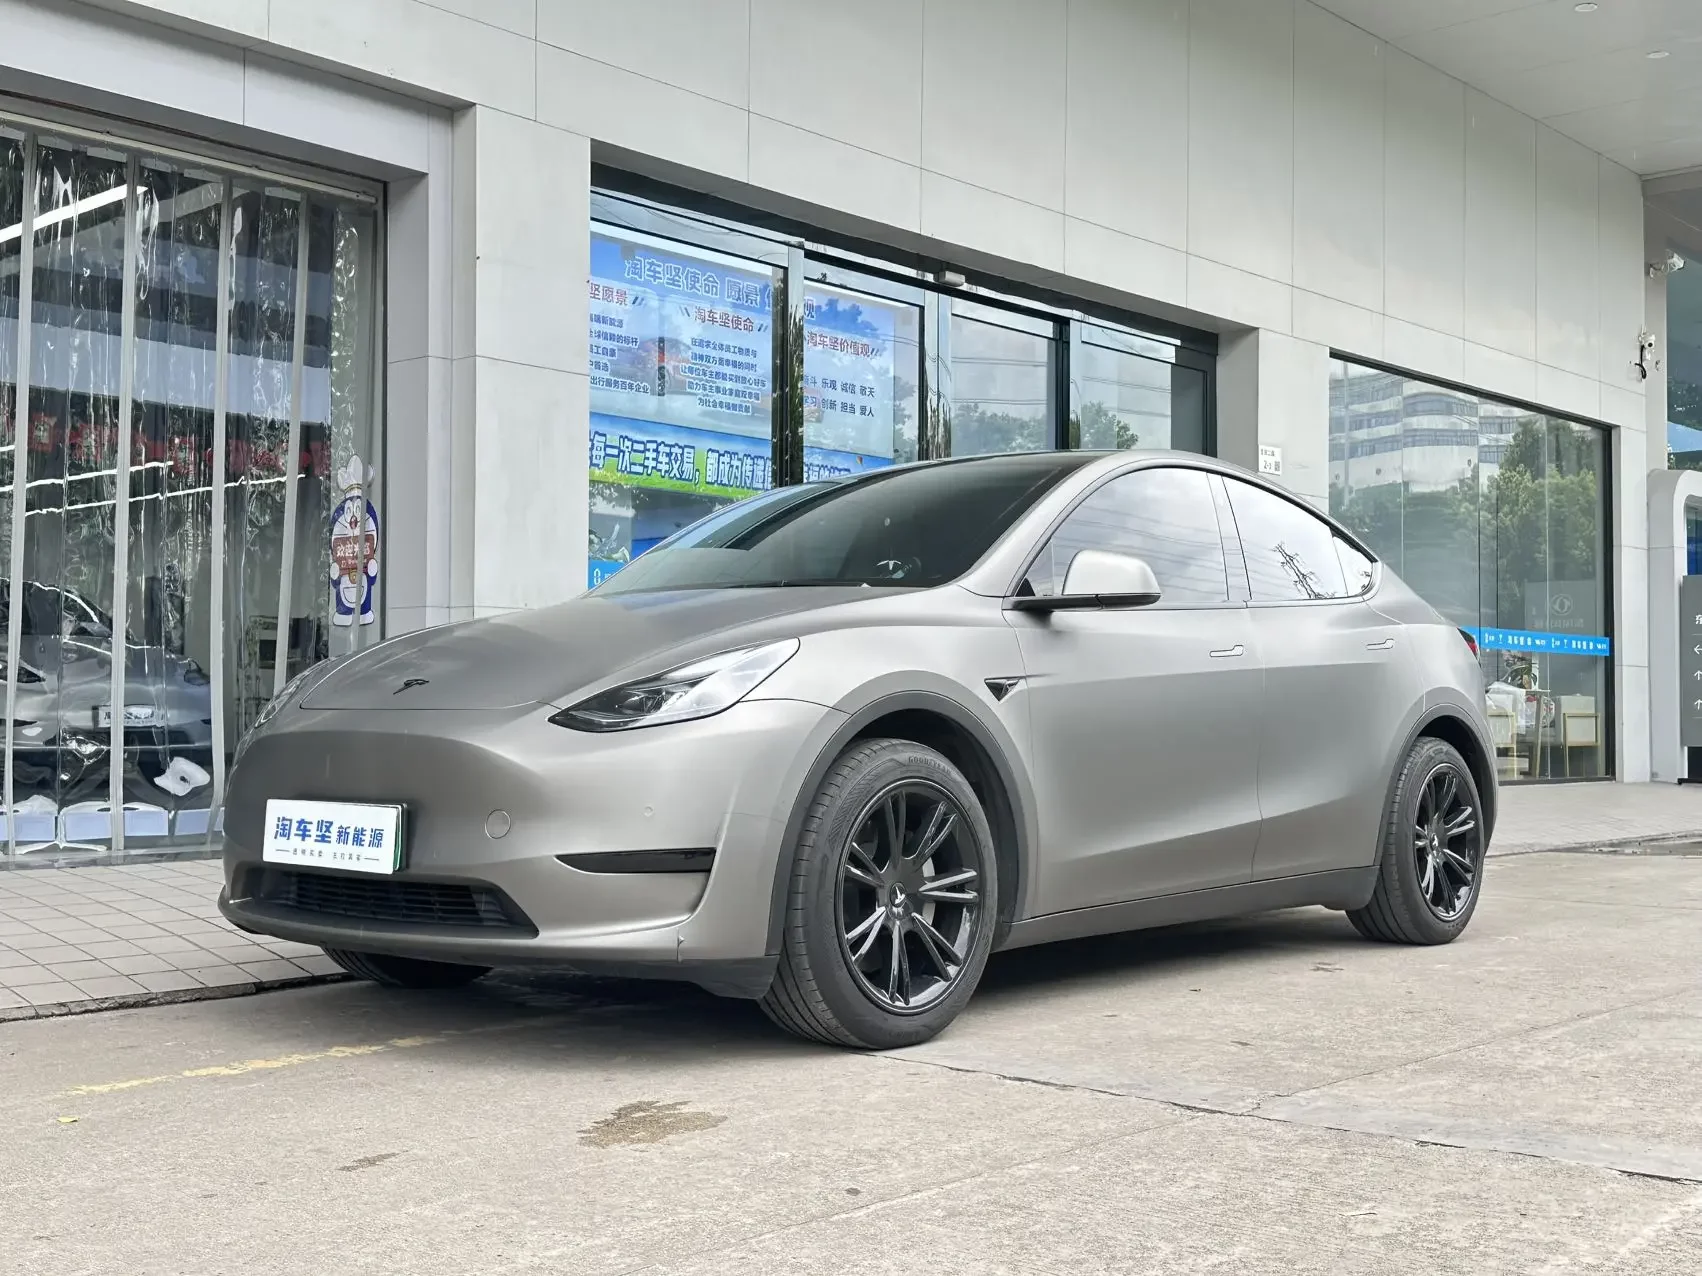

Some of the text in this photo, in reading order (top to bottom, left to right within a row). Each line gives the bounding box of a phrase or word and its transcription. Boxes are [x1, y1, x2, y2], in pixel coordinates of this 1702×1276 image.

[624, 256, 720, 298] 淘车坚使命
[695, 306, 754, 333] 淘车坚使命
[807, 330, 869, 357] 淘车坚价值观
[590, 376, 650, 394] 出行服务百年企业
[274, 816, 385, 849] 淘车坚 新能源
